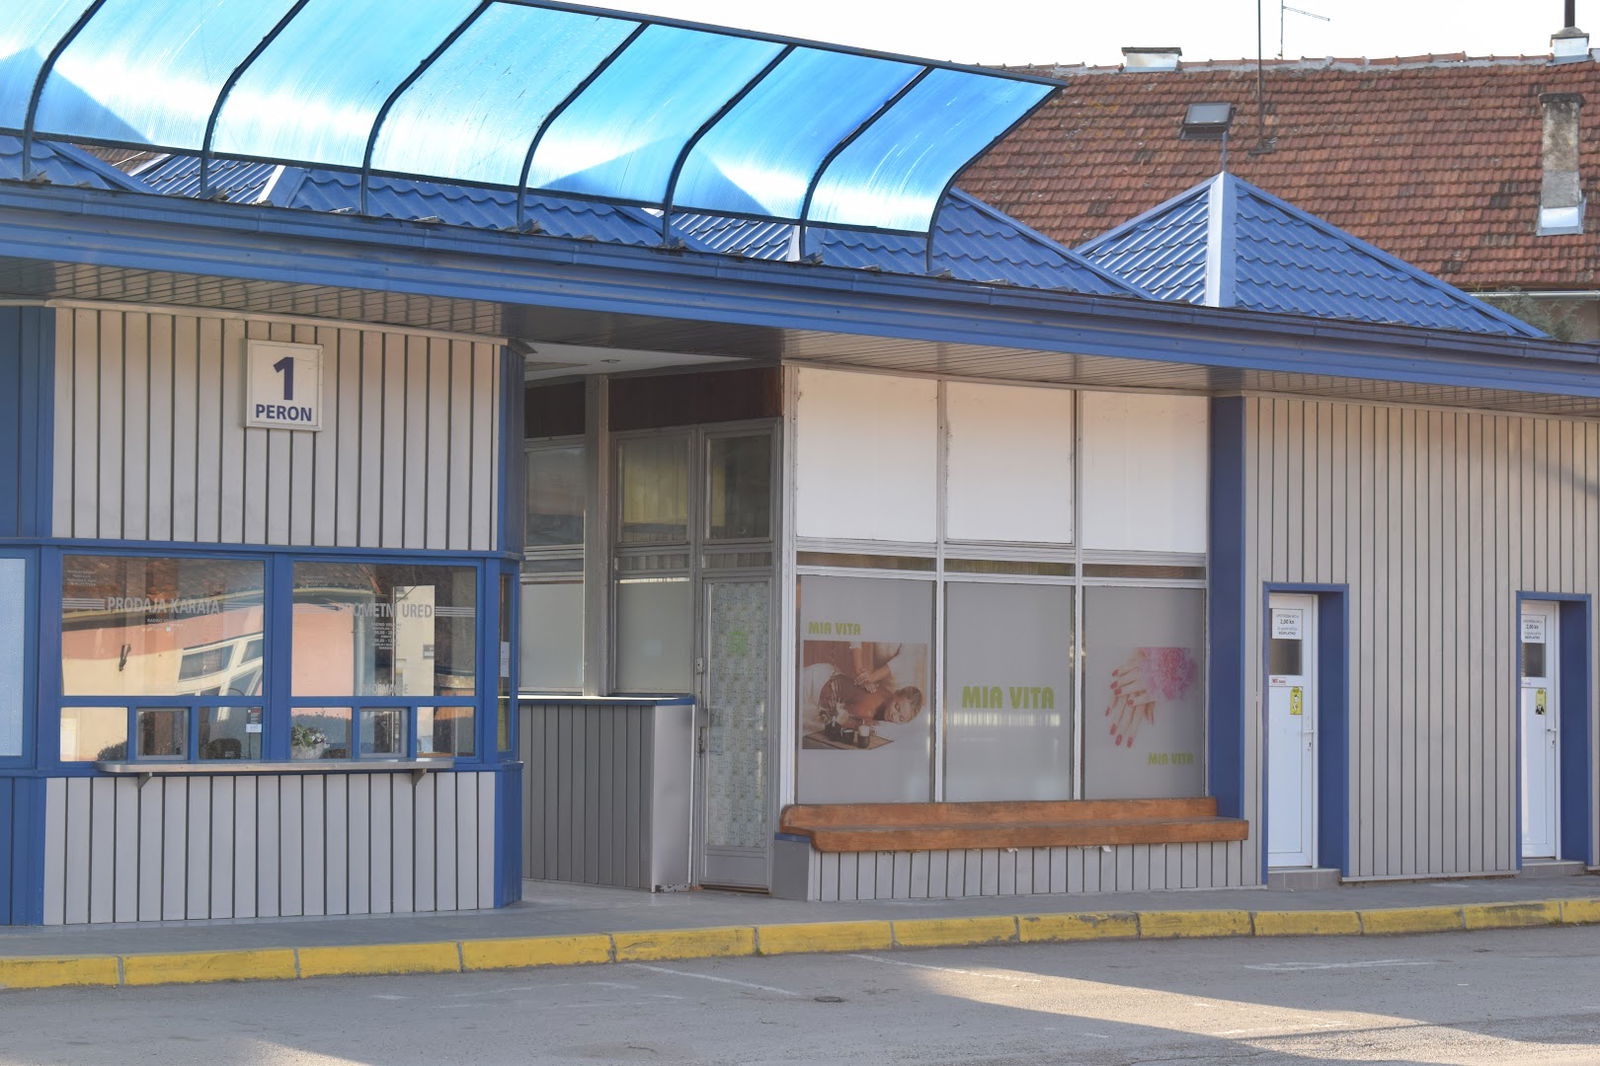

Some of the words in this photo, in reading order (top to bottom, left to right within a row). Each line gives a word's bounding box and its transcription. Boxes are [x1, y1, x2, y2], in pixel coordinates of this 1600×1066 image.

[273, 356, 294, 401] 1
[255, 403, 312, 422] PERON
[107, 596, 167, 613] PRODAJA
[170, 598, 220, 614] KARATA
[402, 603, 433, 618] URED
[808, 621, 832, 635] MIA
[835, 622, 861, 636] VITA
[962, 686, 1003, 709] MIA
[1008, 686, 1055, 710] VITA
[1147, 751, 1169, 766] MIA
[1171, 751, 1194, 766] VITA
